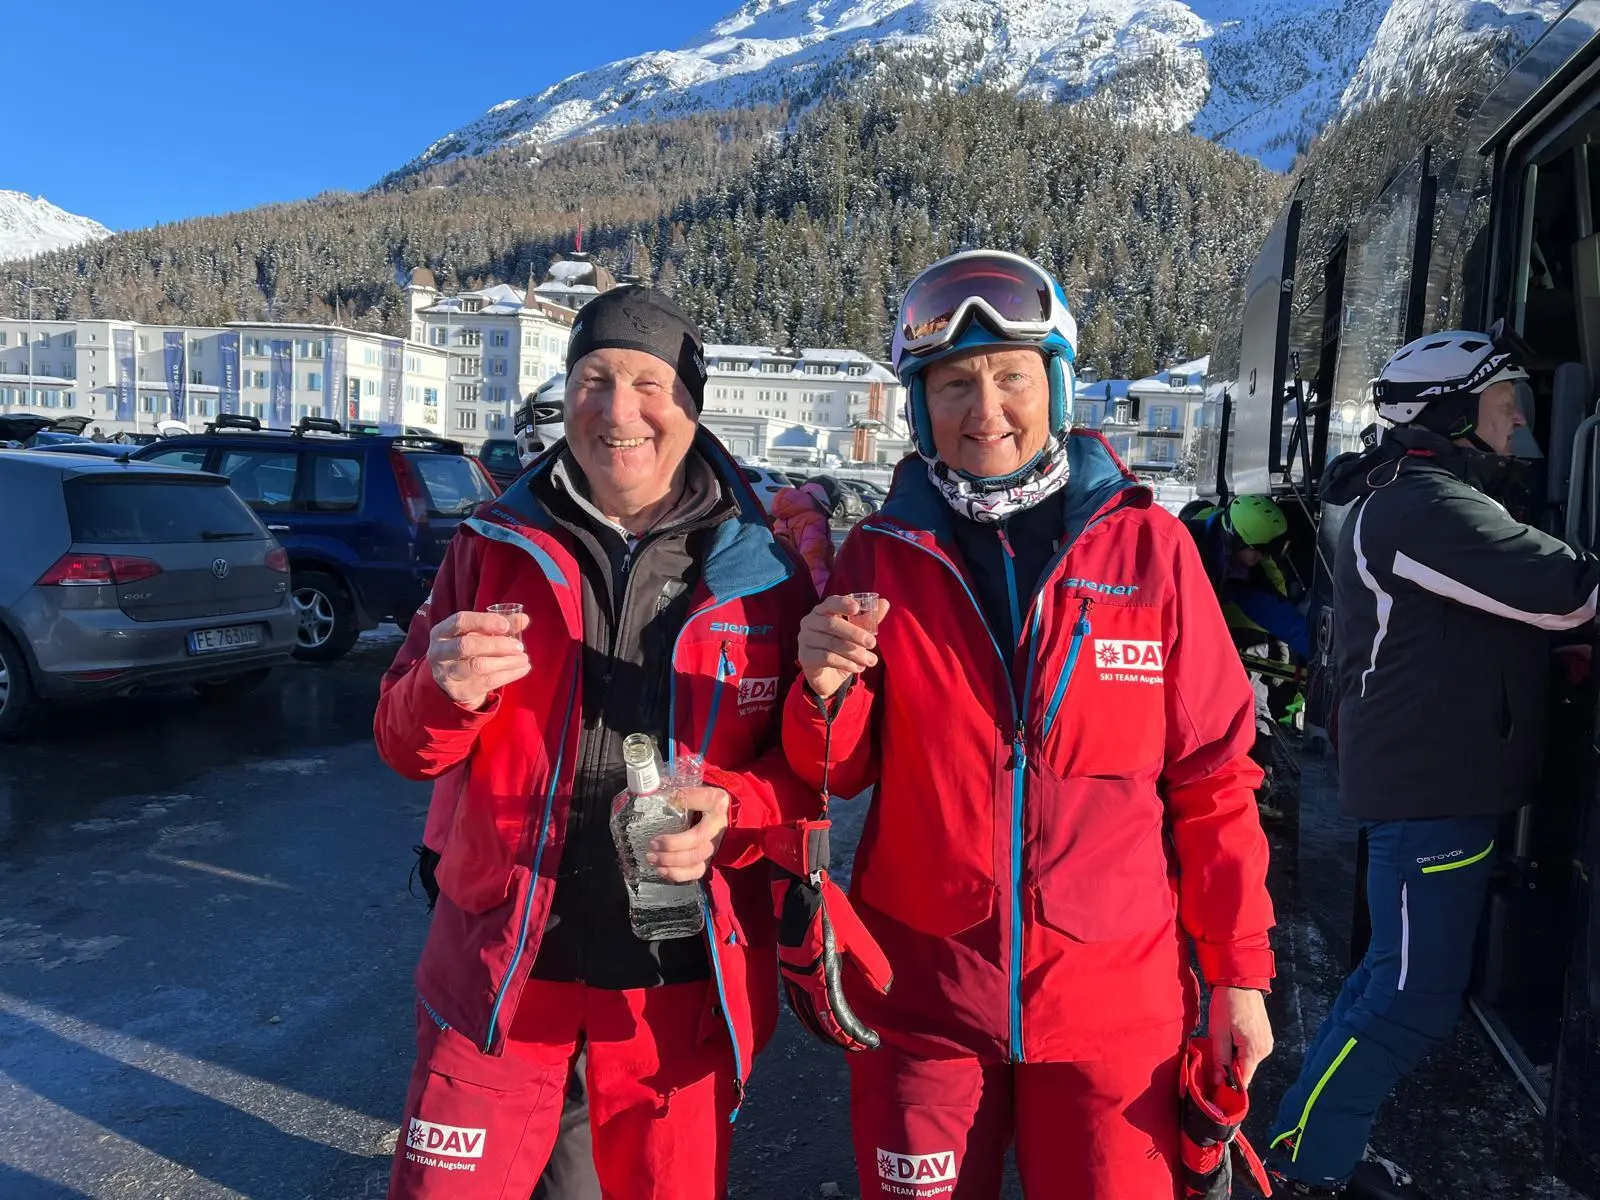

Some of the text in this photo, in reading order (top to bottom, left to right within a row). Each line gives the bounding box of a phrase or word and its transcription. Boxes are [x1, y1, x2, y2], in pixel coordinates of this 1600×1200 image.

[1122, 644, 1163, 667] DA
[1099, 672, 1113, 681] SKI
[1115, 673, 1138, 682] TEAM
[751, 680, 776, 698] DA
[1416, 849, 1465, 864] ORTOVOX
[426, 1127, 482, 1153] DAV
[406, 1151, 476, 1172] SKI TEAM Augsburg
[896, 1155, 951, 1180] DAV
[881, 1182, 953, 1198] SKI TEAM Augsburg
